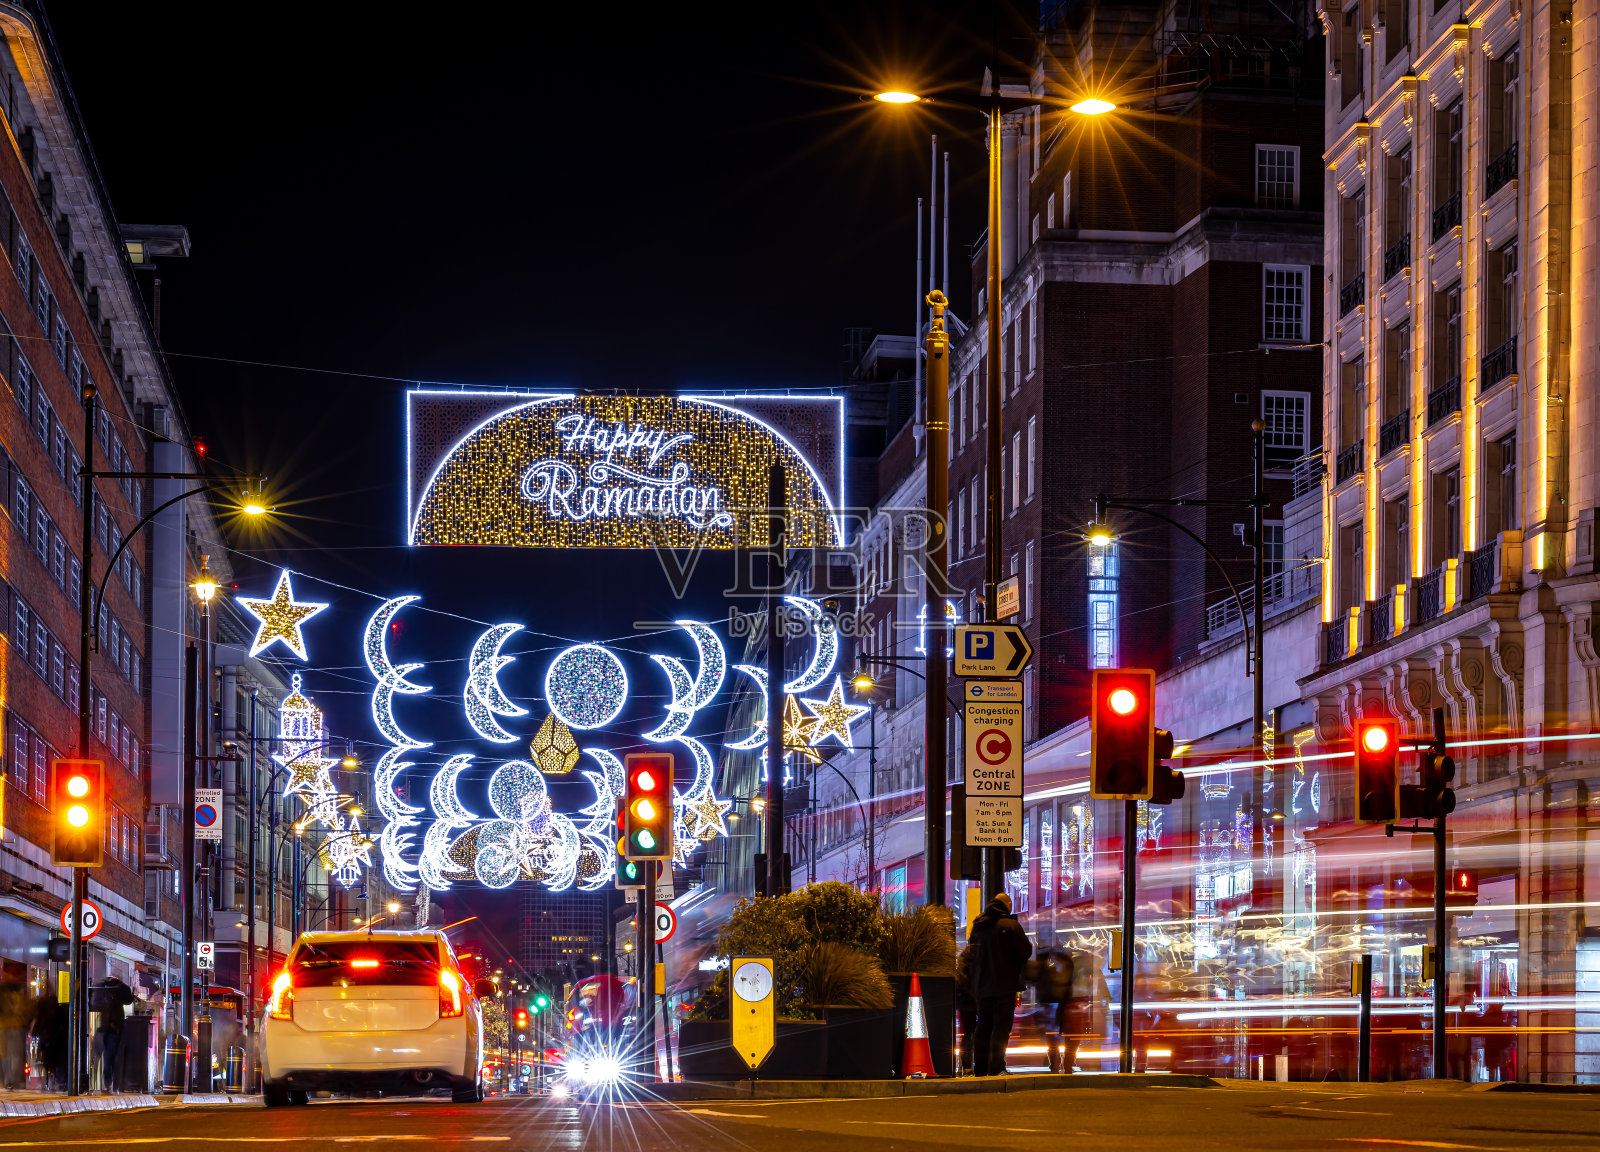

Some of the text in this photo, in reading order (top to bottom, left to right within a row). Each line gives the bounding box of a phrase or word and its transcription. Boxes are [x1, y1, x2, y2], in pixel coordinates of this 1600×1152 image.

[556, 414, 694, 468] Happy
[521, 460, 733, 529] Ramadan
[970, 633, 989, 657] P
[968, 706, 1020, 716] Congestion
[974, 716, 1014, 726] charging
[972, 768, 1016, 778] Central
[976, 781, 1011, 791] ZONE
[656, 914, 671, 931] 0
